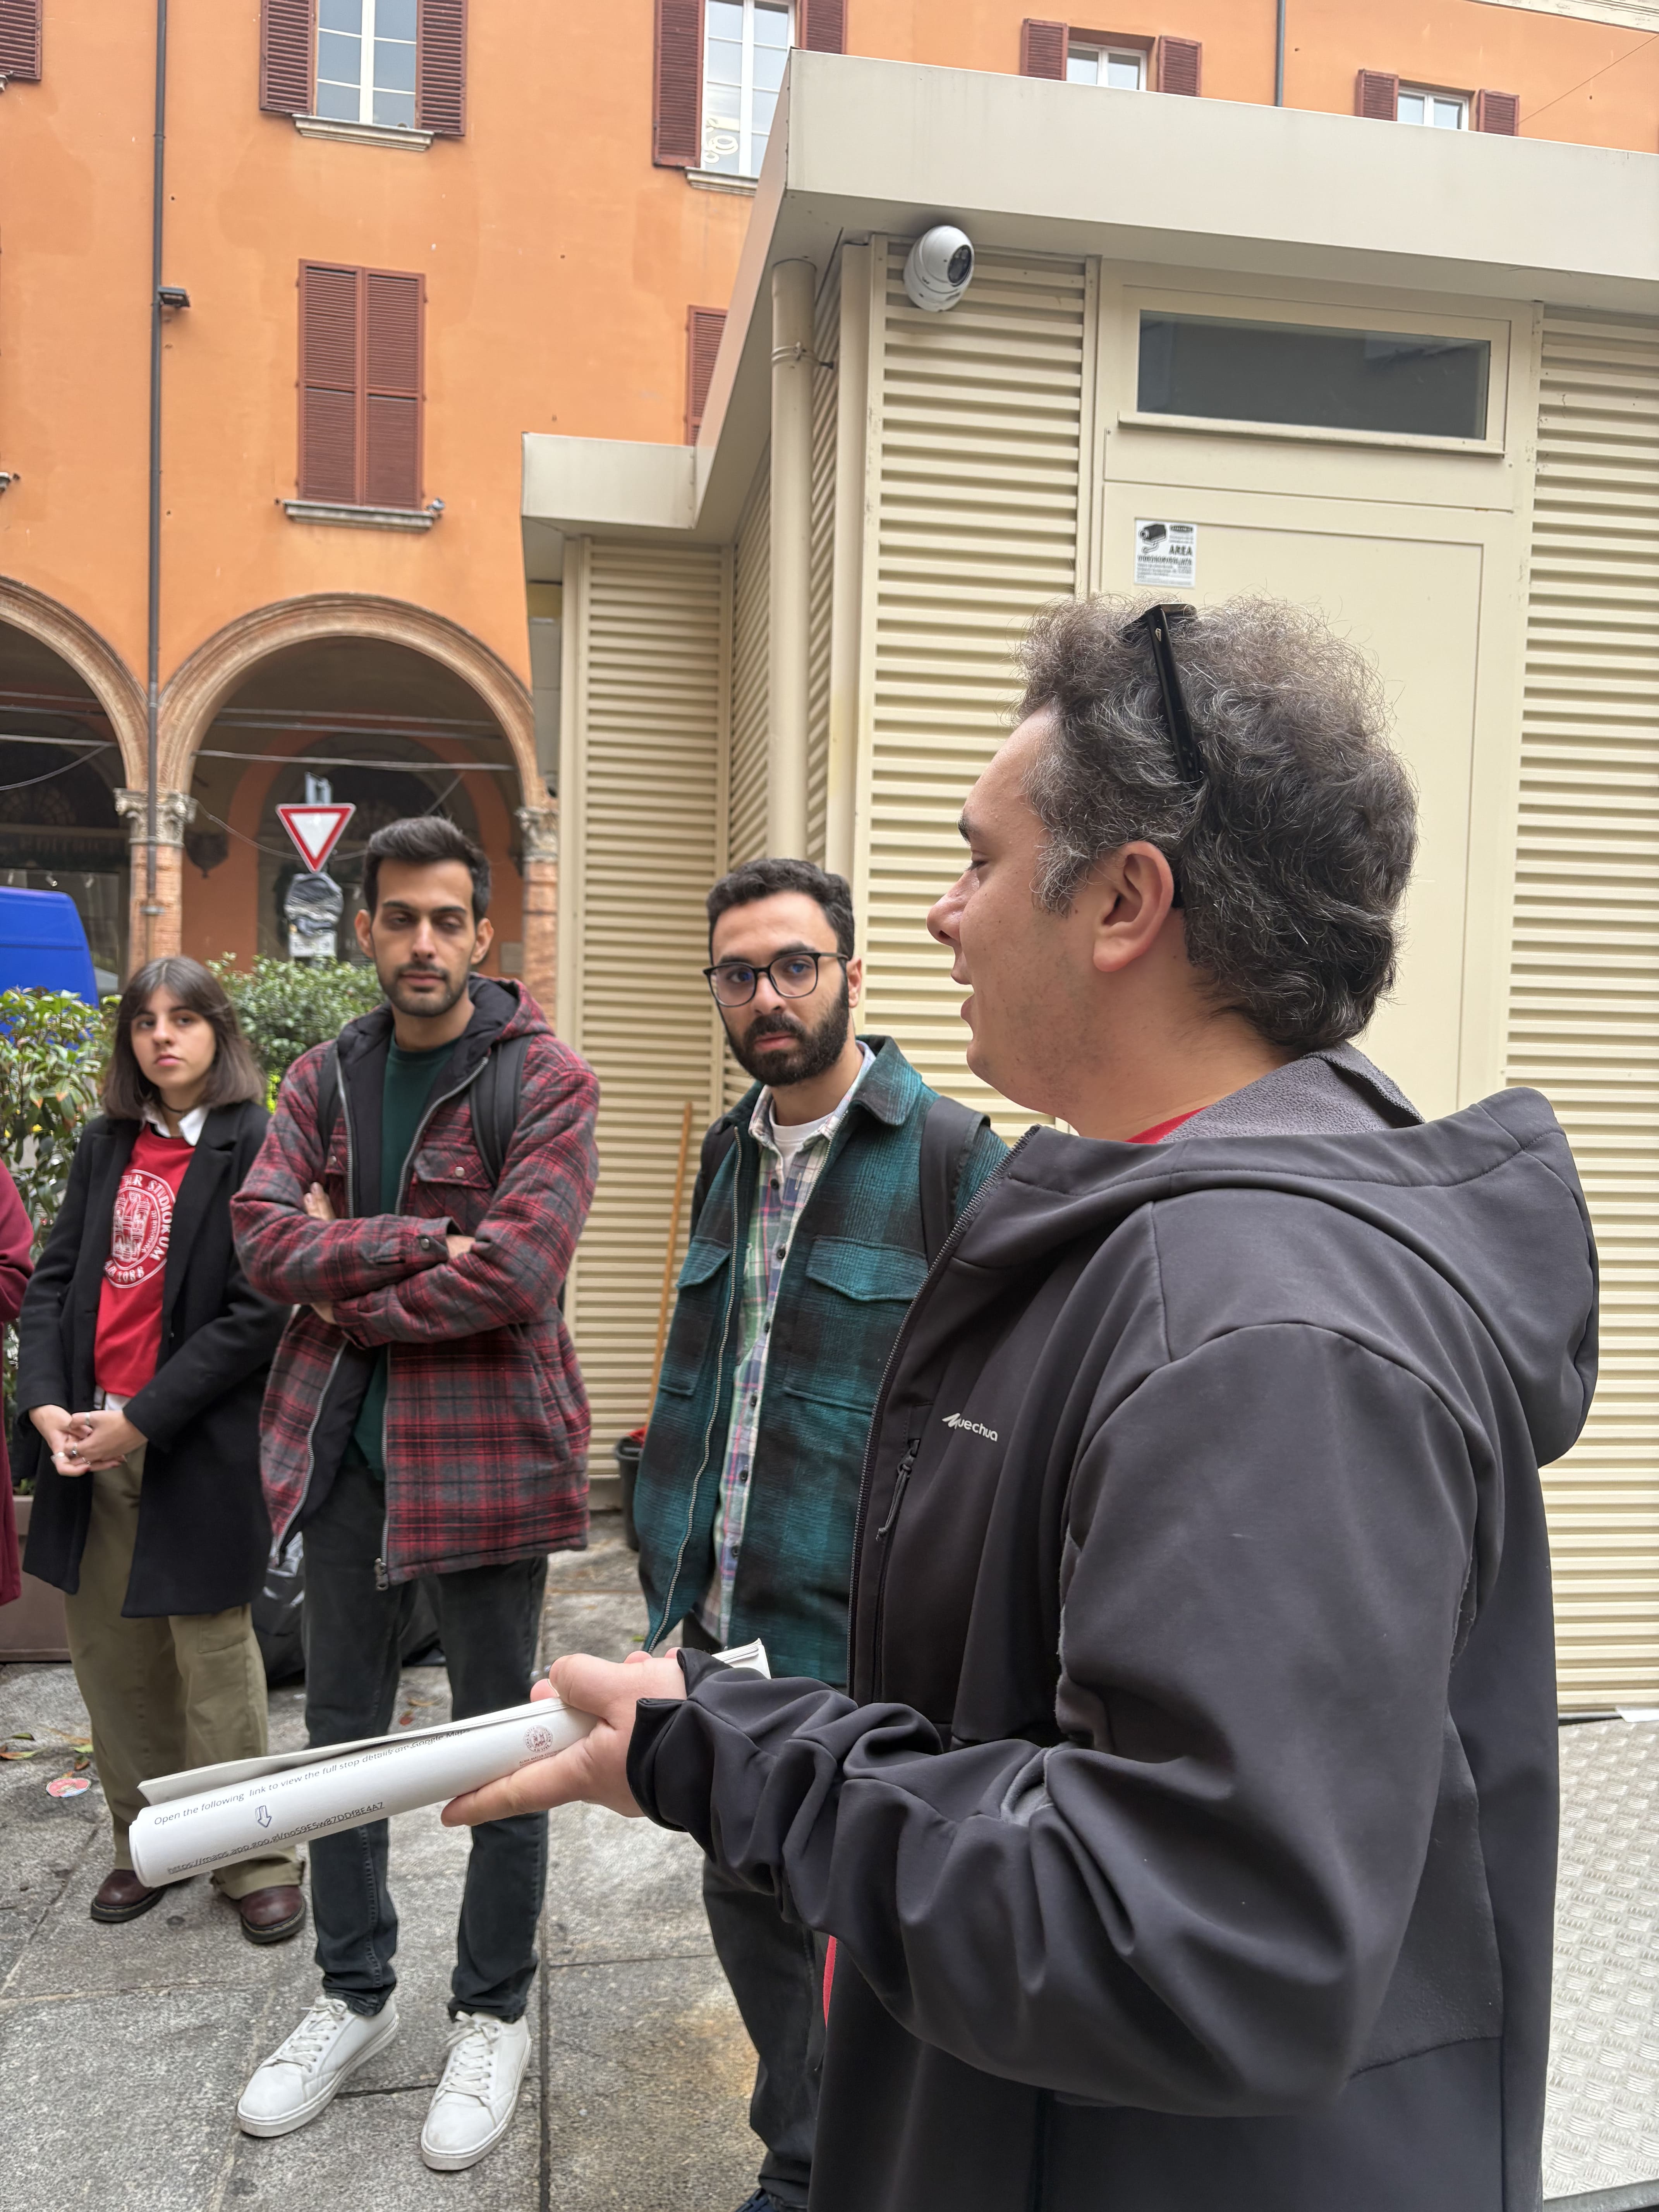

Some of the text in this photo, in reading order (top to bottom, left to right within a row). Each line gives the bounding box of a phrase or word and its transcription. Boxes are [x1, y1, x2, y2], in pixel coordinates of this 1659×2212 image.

[1169, 544, 1192, 556] AREA
[154, 1813, 180, 1826] Open
[183, 1807, 198, 1817] the
[201, 1793, 244, 1811] following
[249, 1786, 266, 1797] link
[281, 1776, 302, 1786] view
[305, 1771, 319, 1780] the
[322, 1765, 337, 1774] full
[339, 1759, 359, 1770] stop
